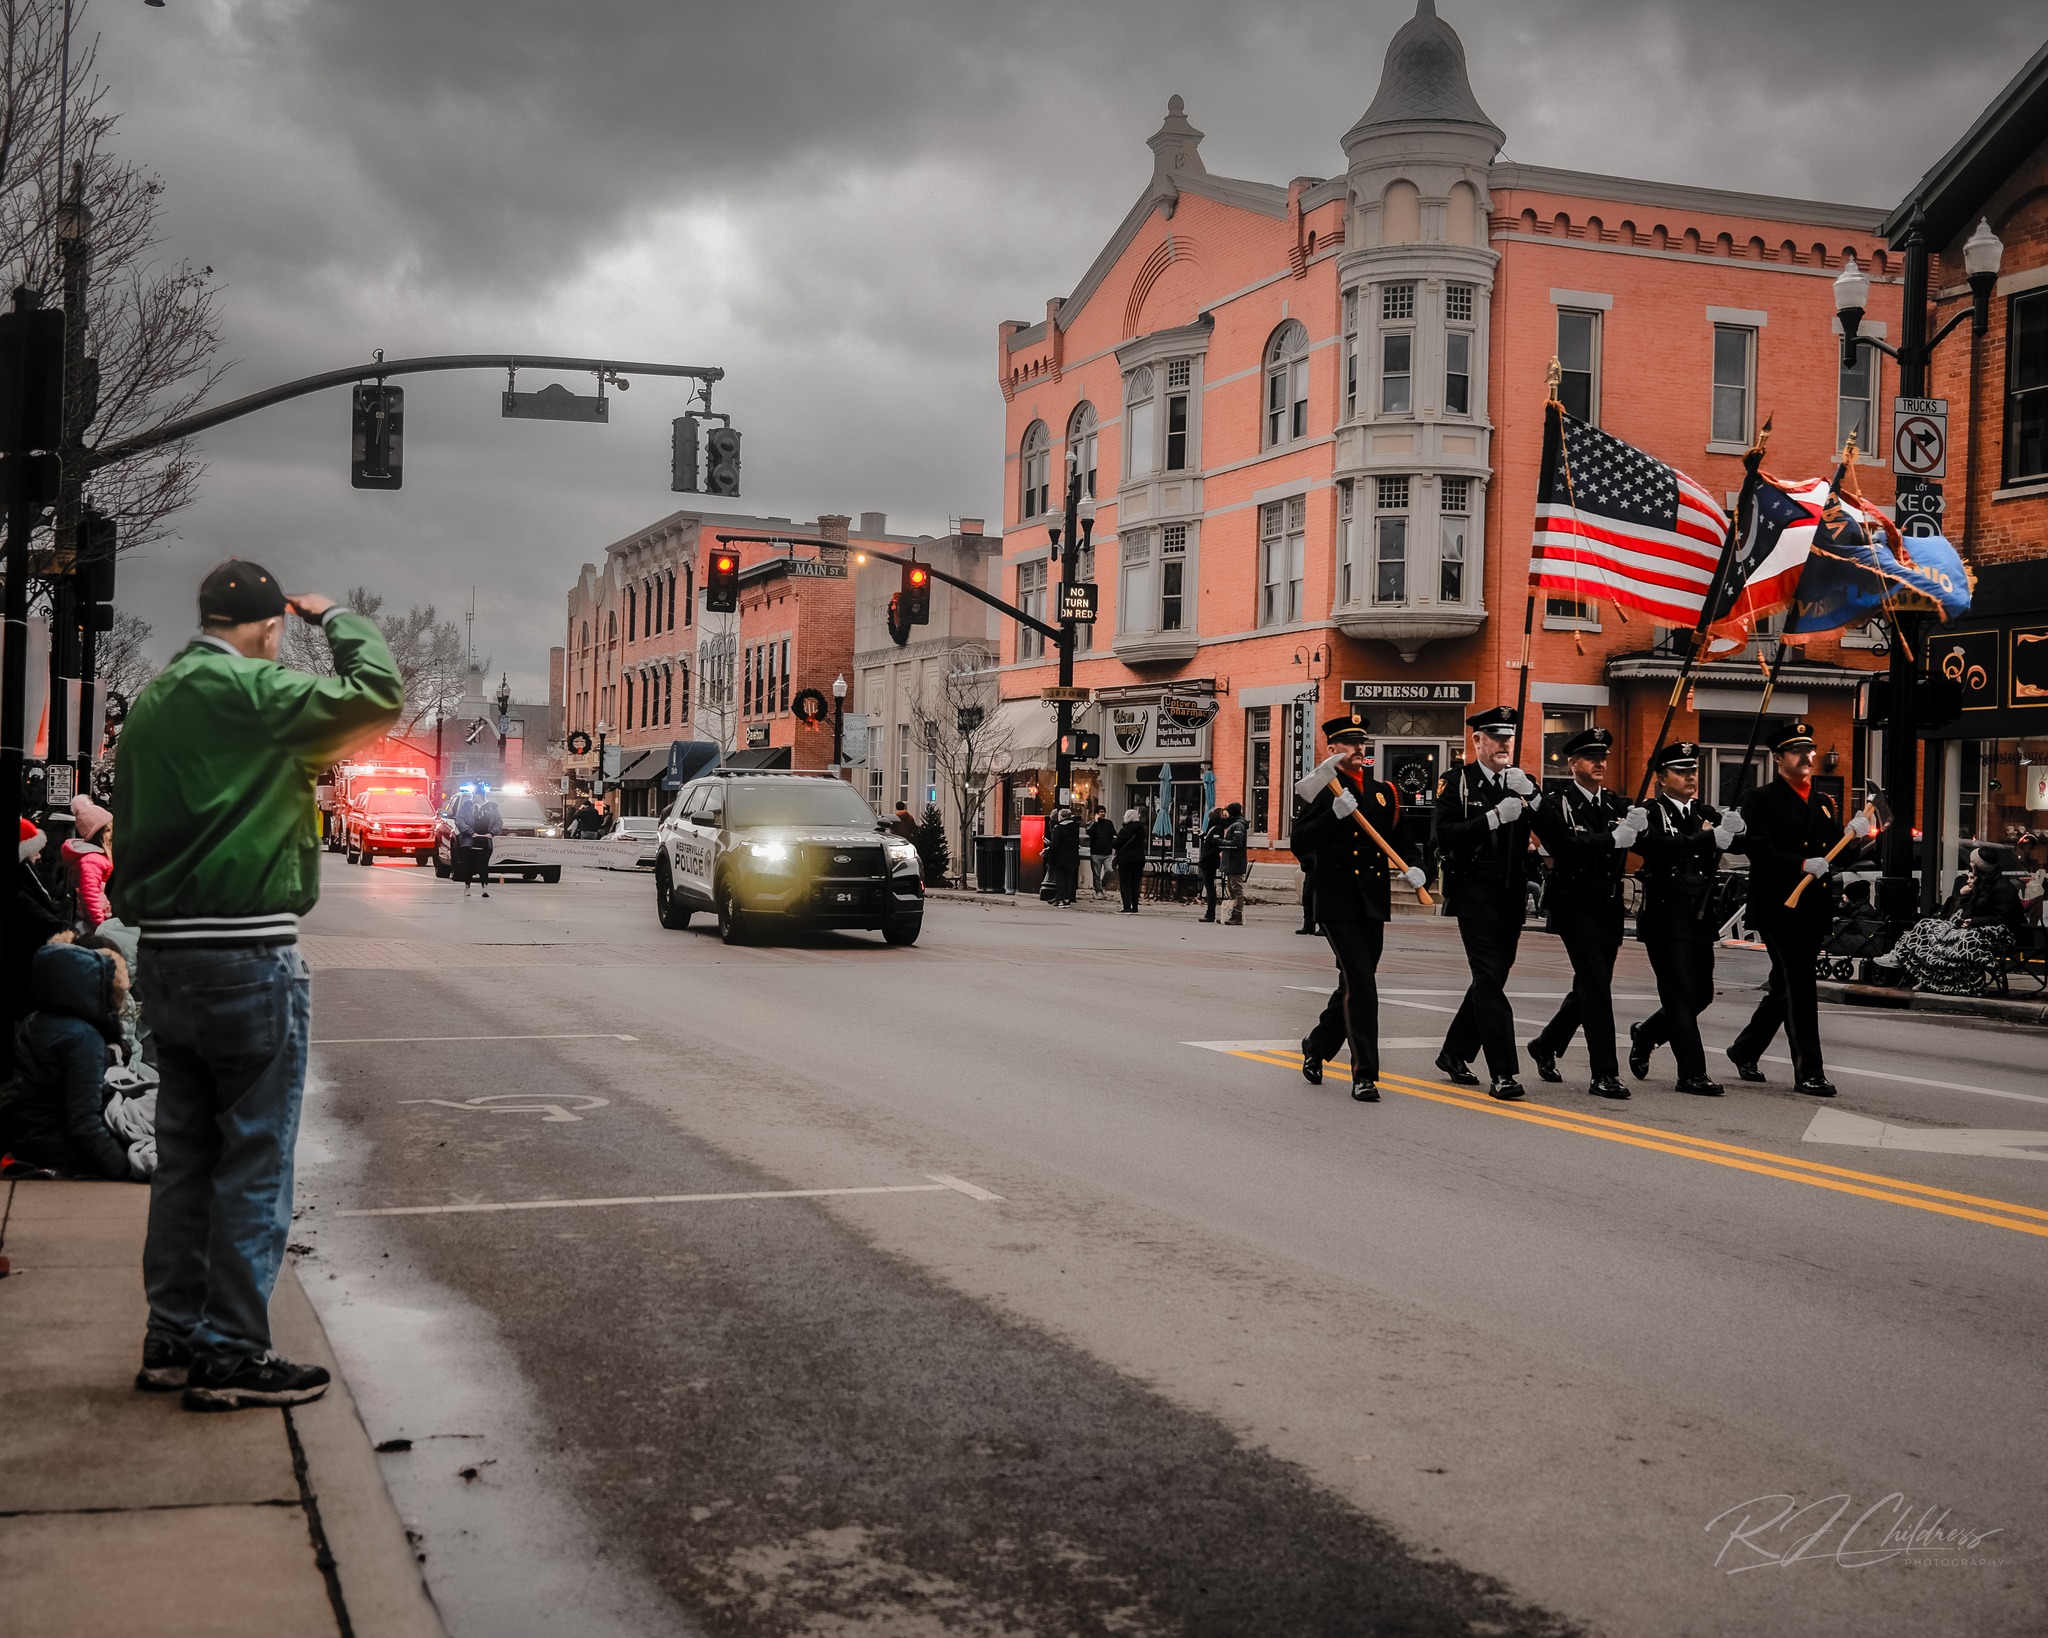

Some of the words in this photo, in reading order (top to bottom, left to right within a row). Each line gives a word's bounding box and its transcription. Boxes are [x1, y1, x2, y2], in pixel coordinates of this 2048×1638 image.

[1902, 399, 1938, 413] TRUCKS
[1915, 484, 1928, 492] LOT
[795, 563, 827, 576] MAIN
[829, 568, 840, 576] ST
[1070, 587, 1085, 597] NO
[1065, 597, 1089, 608] TURN
[1075, 609, 1094, 619] RED
[1355, 685, 1429, 698] ESPRESSO
[1433, 686, 1460, 699] AIR
[1164, 698, 1198, 708] Uptown
[1170, 707, 1213, 718] pharmacy
[675, 841, 704, 857] WESTERVILLE
[675, 853, 704, 877] POLICE
[836, 893, 852, 902] 21
